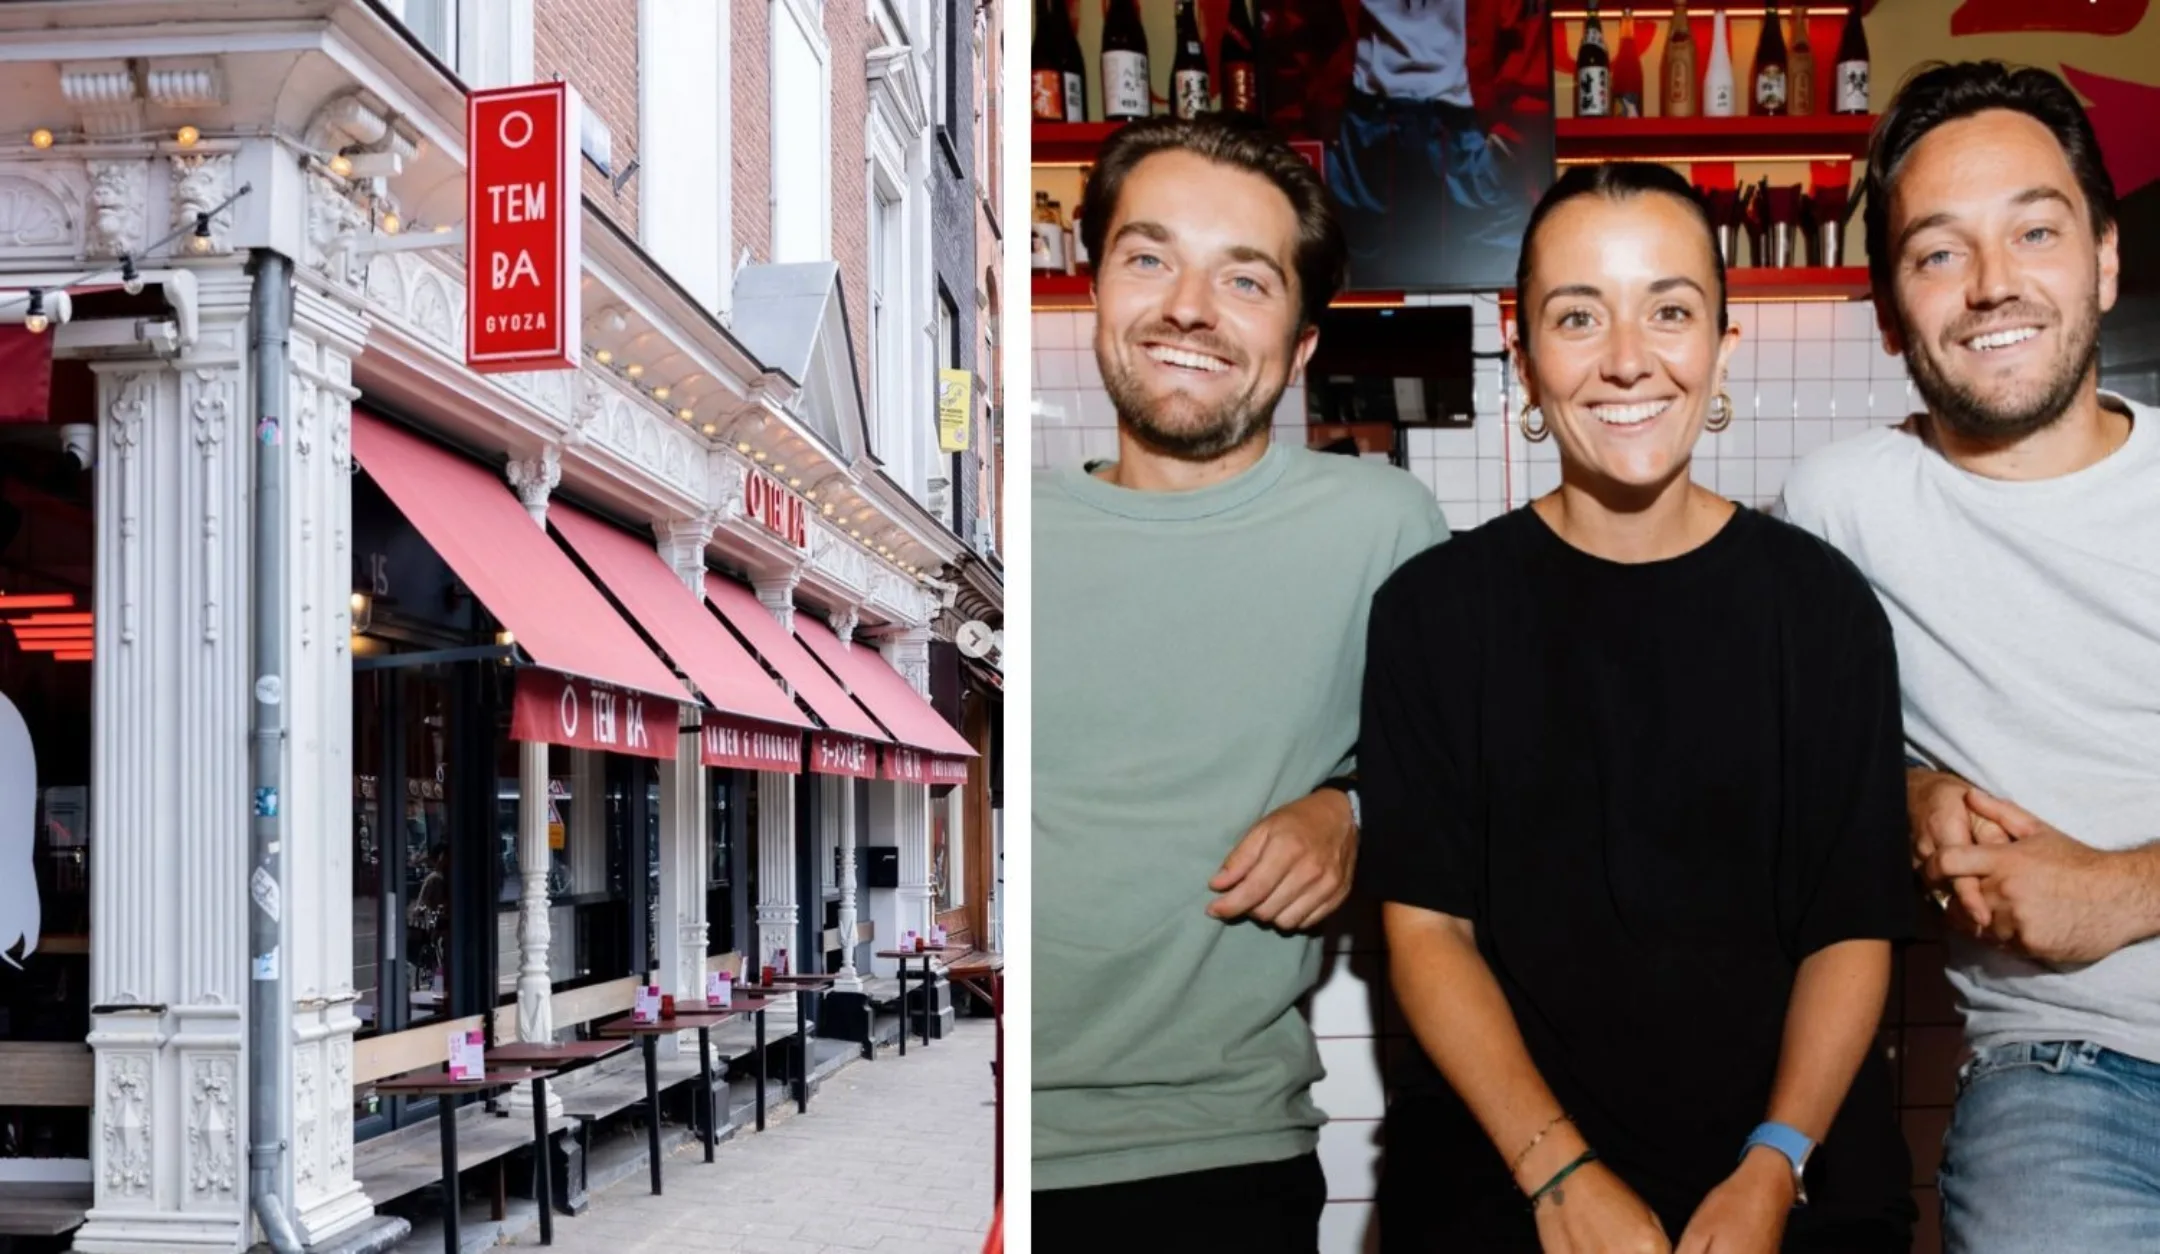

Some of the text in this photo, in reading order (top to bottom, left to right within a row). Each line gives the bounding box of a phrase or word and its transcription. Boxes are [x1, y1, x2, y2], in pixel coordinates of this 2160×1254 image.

[499, 110, 534, 149] O
[487, 181, 546, 224] TEM
[491, 249, 541, 290] BA
[485, 312, 547, 333] GYOZA
[745, 468, 761, 518] O
[370, 552, 389, 596] 15
[561, 684, 648, 750] O TEM BA
